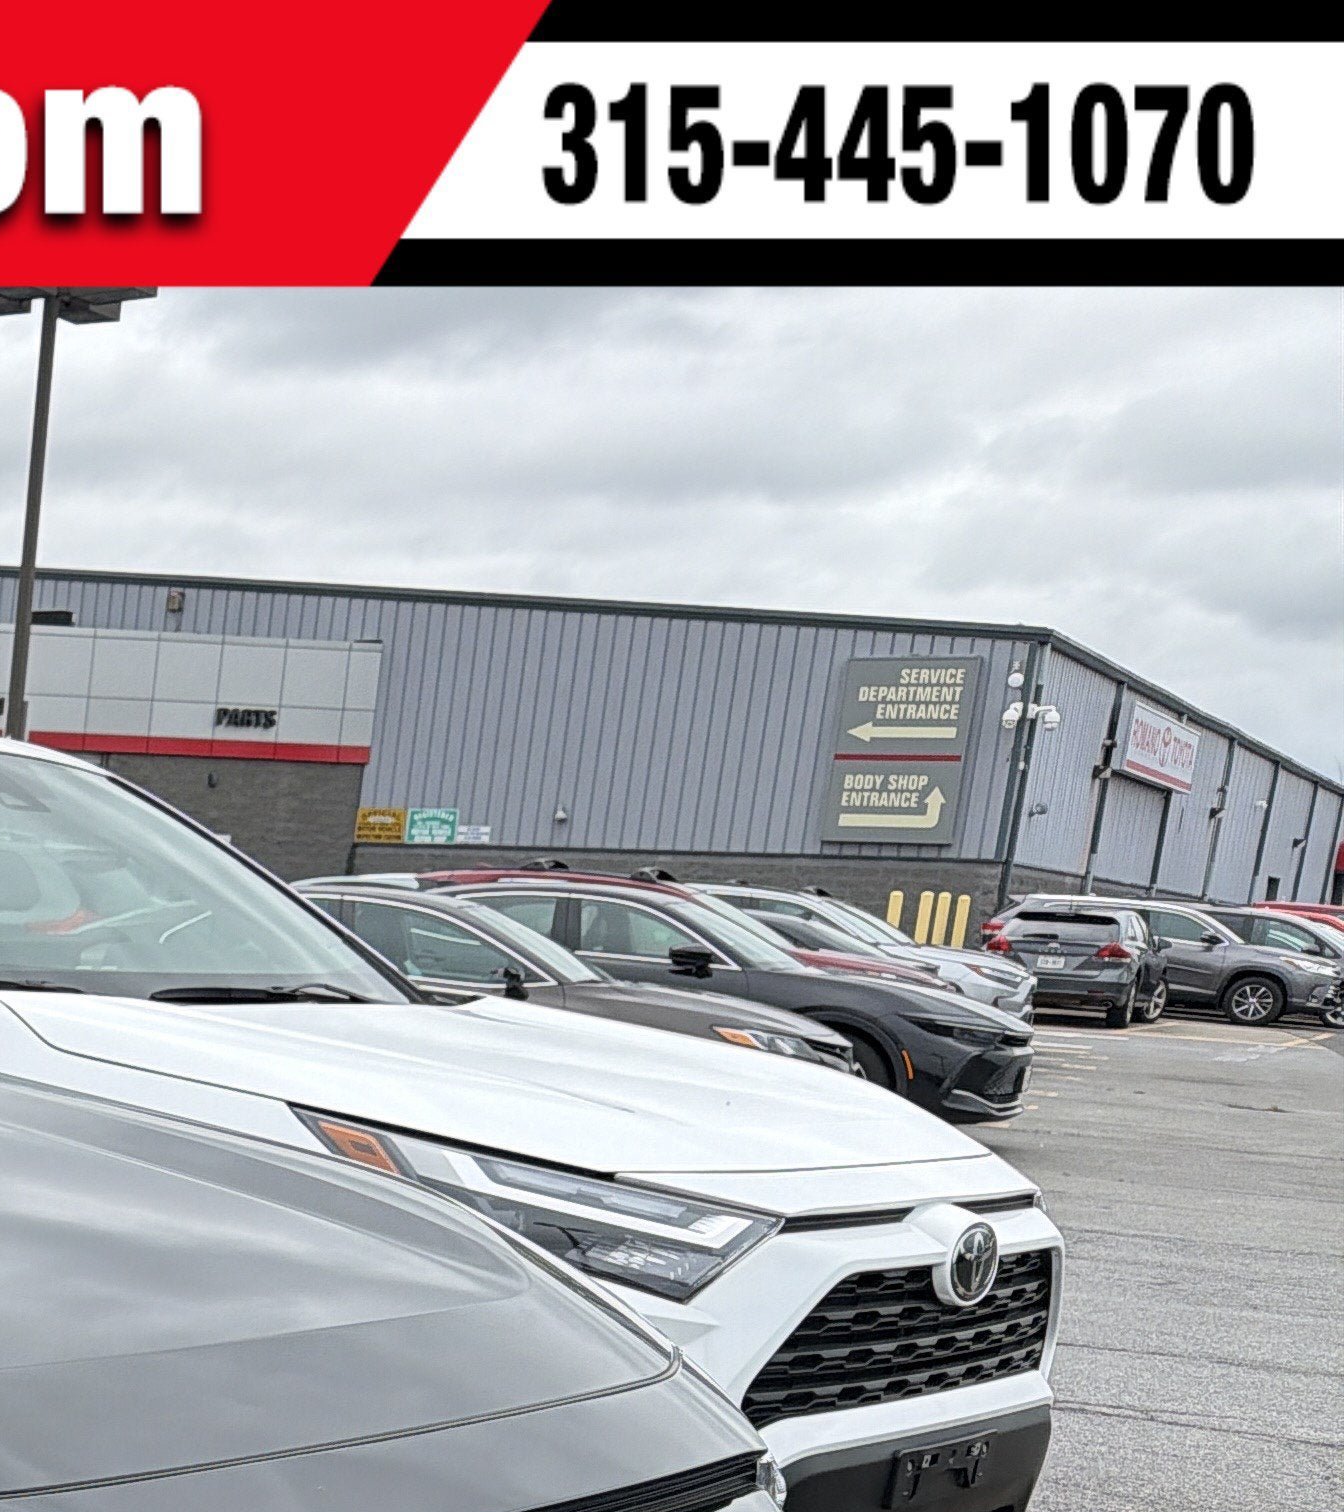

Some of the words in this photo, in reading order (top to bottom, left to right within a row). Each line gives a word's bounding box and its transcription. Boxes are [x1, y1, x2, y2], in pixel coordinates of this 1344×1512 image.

[900, 668, 966, 684] SERVICE
[858, 686, 963, 702] DEPARTMENT
[216, 707, 277, 729] PARTS
[876, 703, 960, 720] ENTRANCE
[844, 774, 884, 790] BODY
[888, 775, 929, 791] SHOP
[841, 791, 920, 807] ENTRANCE
